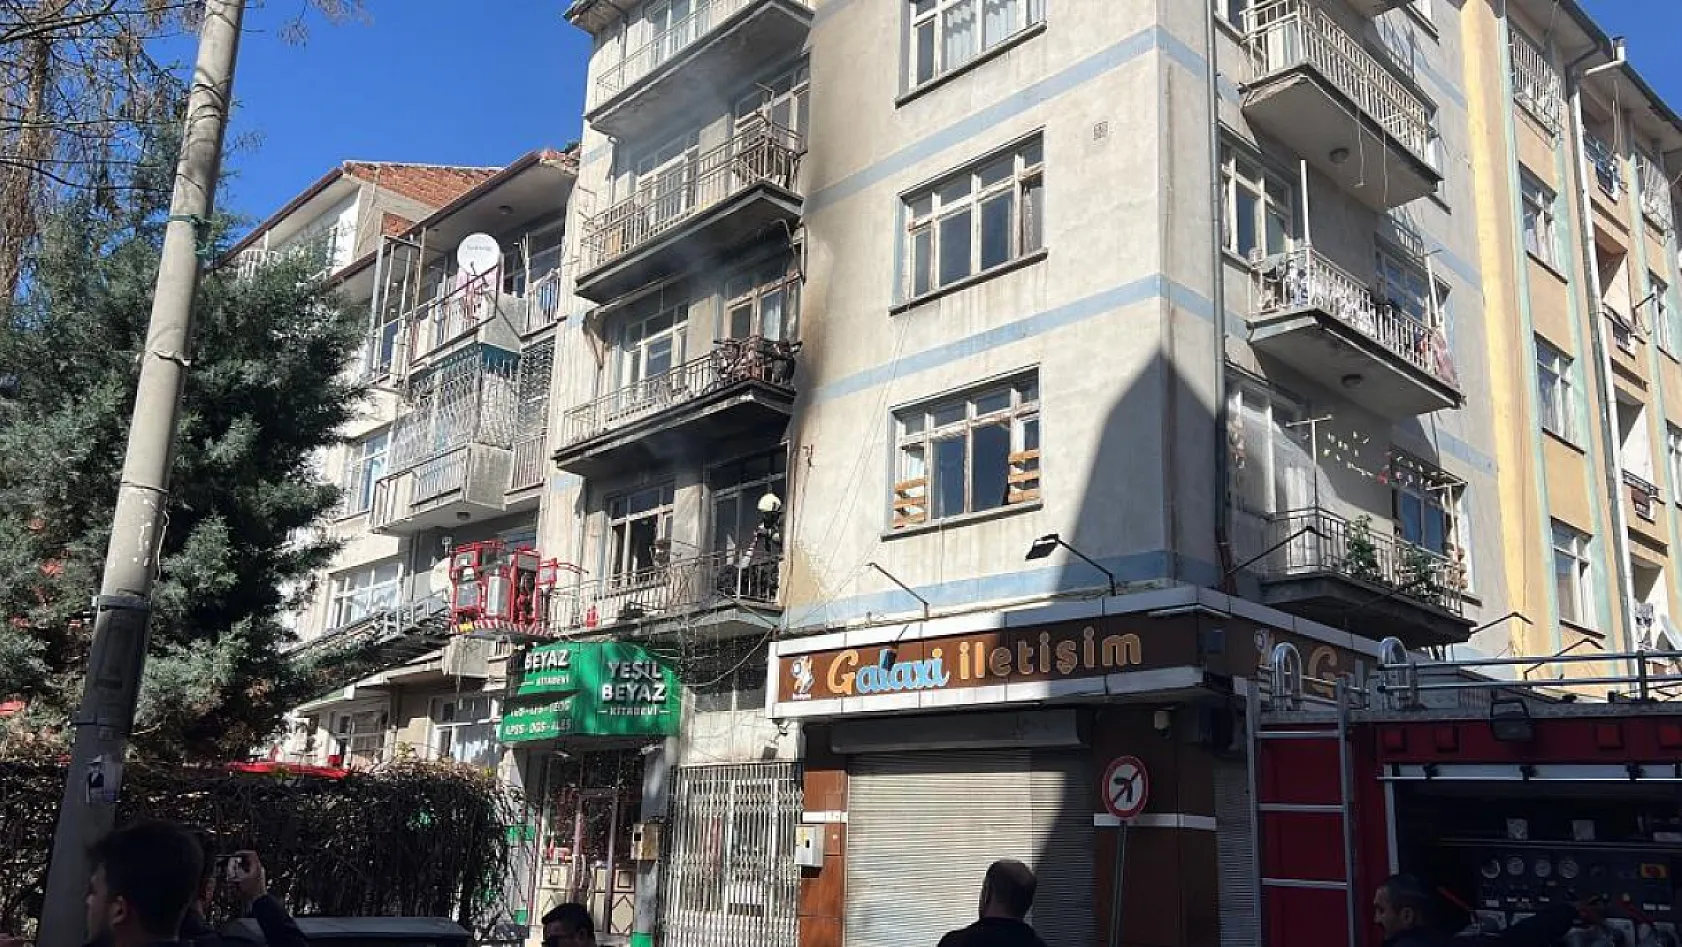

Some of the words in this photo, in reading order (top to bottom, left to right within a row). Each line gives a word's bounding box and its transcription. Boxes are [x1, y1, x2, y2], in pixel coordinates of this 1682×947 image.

[525, 650, 569, 670] BEYAZ
[608, 659, 662, 680] YEŞİL
[827, 648, 950, 695] Galaxi
[958, 626, 1143, 680] iletişim
[601, 682, 667, 702] BEYAZ
